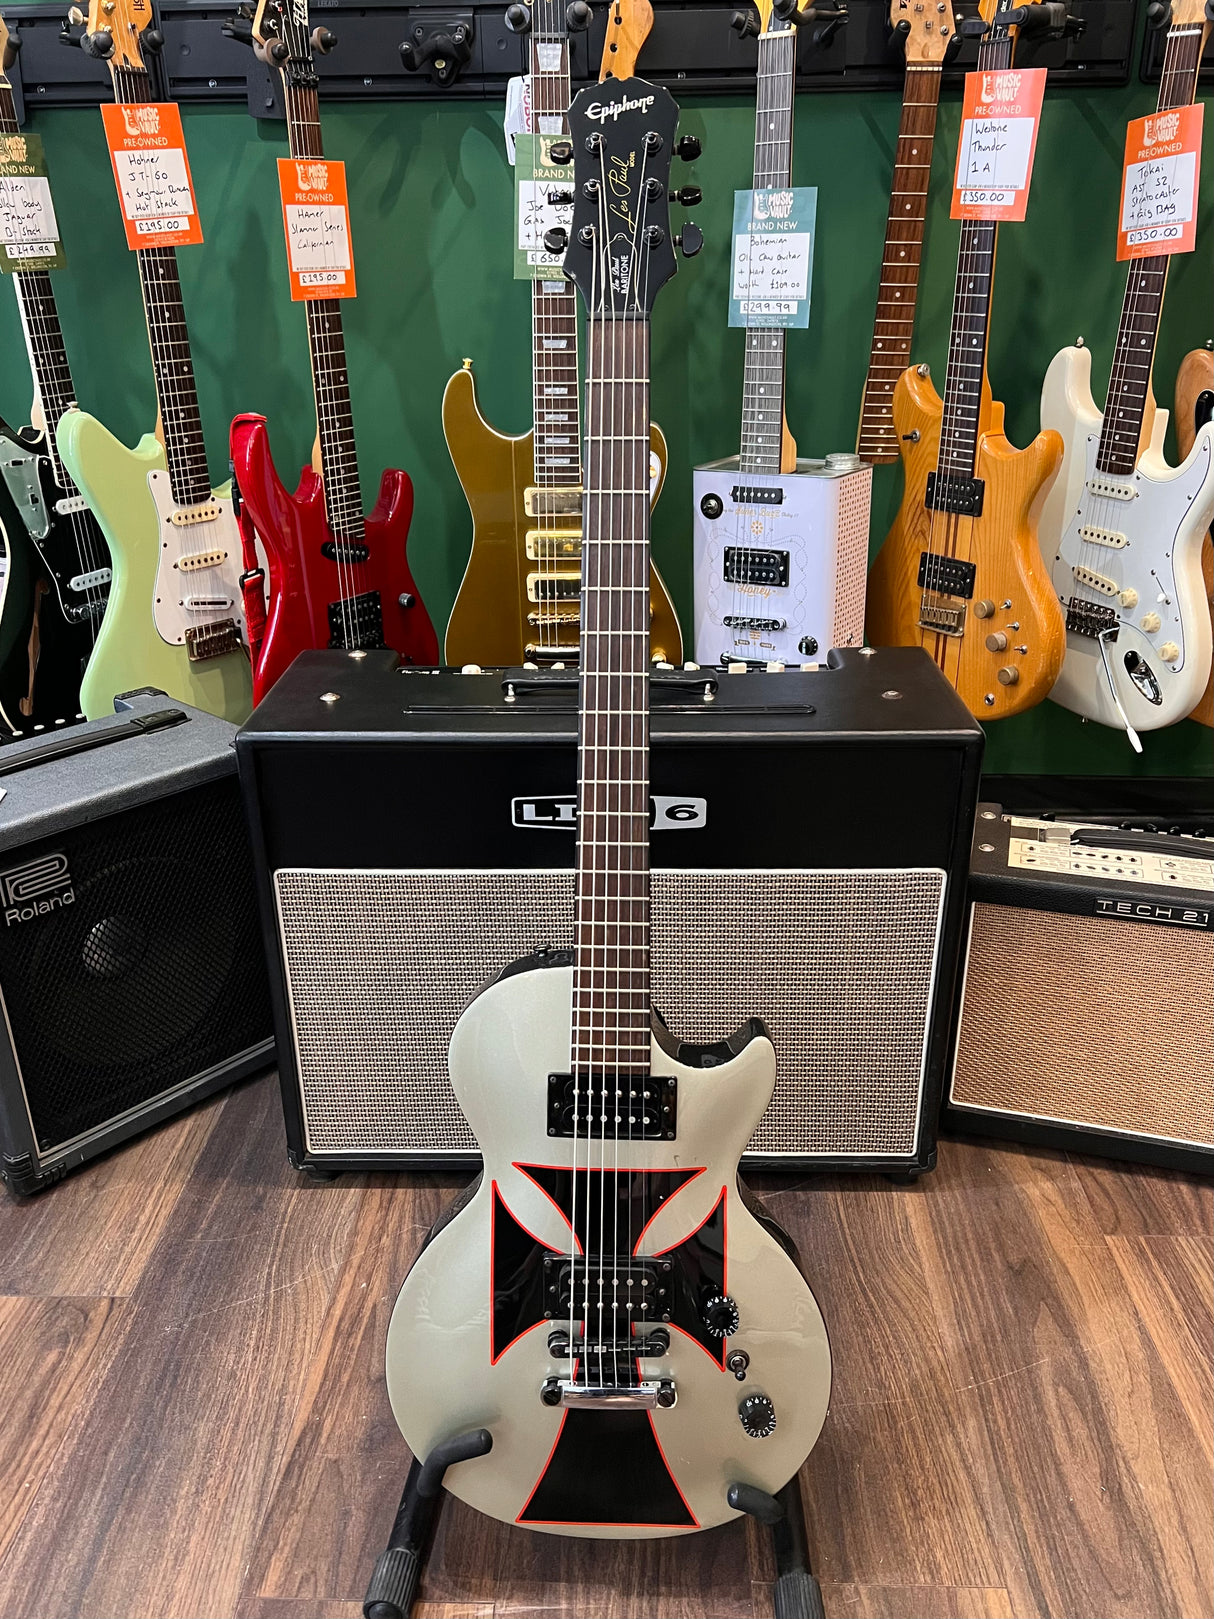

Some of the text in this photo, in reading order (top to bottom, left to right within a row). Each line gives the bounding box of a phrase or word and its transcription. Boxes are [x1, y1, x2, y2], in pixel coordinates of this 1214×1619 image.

[995, 72, 1021, 90] MUSIC
[996, 87, 1019, 103] VAULT
[136, 106, 160, 121] MUSIC
[584, 94, 655, 124] Epiphone
[974, 105, 1021, 115] PRE-OWNED
[139, 120, 161, 134] VAULT
[1156, 112, 1180, 131] MUSIC
[123, 137, 168, 147] PRE-OWNED
[1157, 127, 1179, 142] VAULT
[1137, 142, 1183, 159] PRE-OWNED
[128, 153, 160, 166] Hohner
[0, 165, 35, 174] AND NEW
[308, 163, 328, 179] MUSIC
[533, 168, 565, 179] BRAND
[983, 162, 991, 173] A
[310, 177, 329, 190] VAULT
[607, 155, 631, 197] Paul
[295, 193, 334, 202] PRE-OWNED
[769, 191, 794, 206] MUSIC
[609, 200, 636, 234] Les
[769, 204, 793, 219] VAULT
[747, 221, 798, 231] BRAND NEW
[620, 254, 630, 294] BARITONE
[522, 803, 700, 822] LI 6
[5, 886, 76, 927] Roland
[1097, 900, 1209, 924] TECH 21
